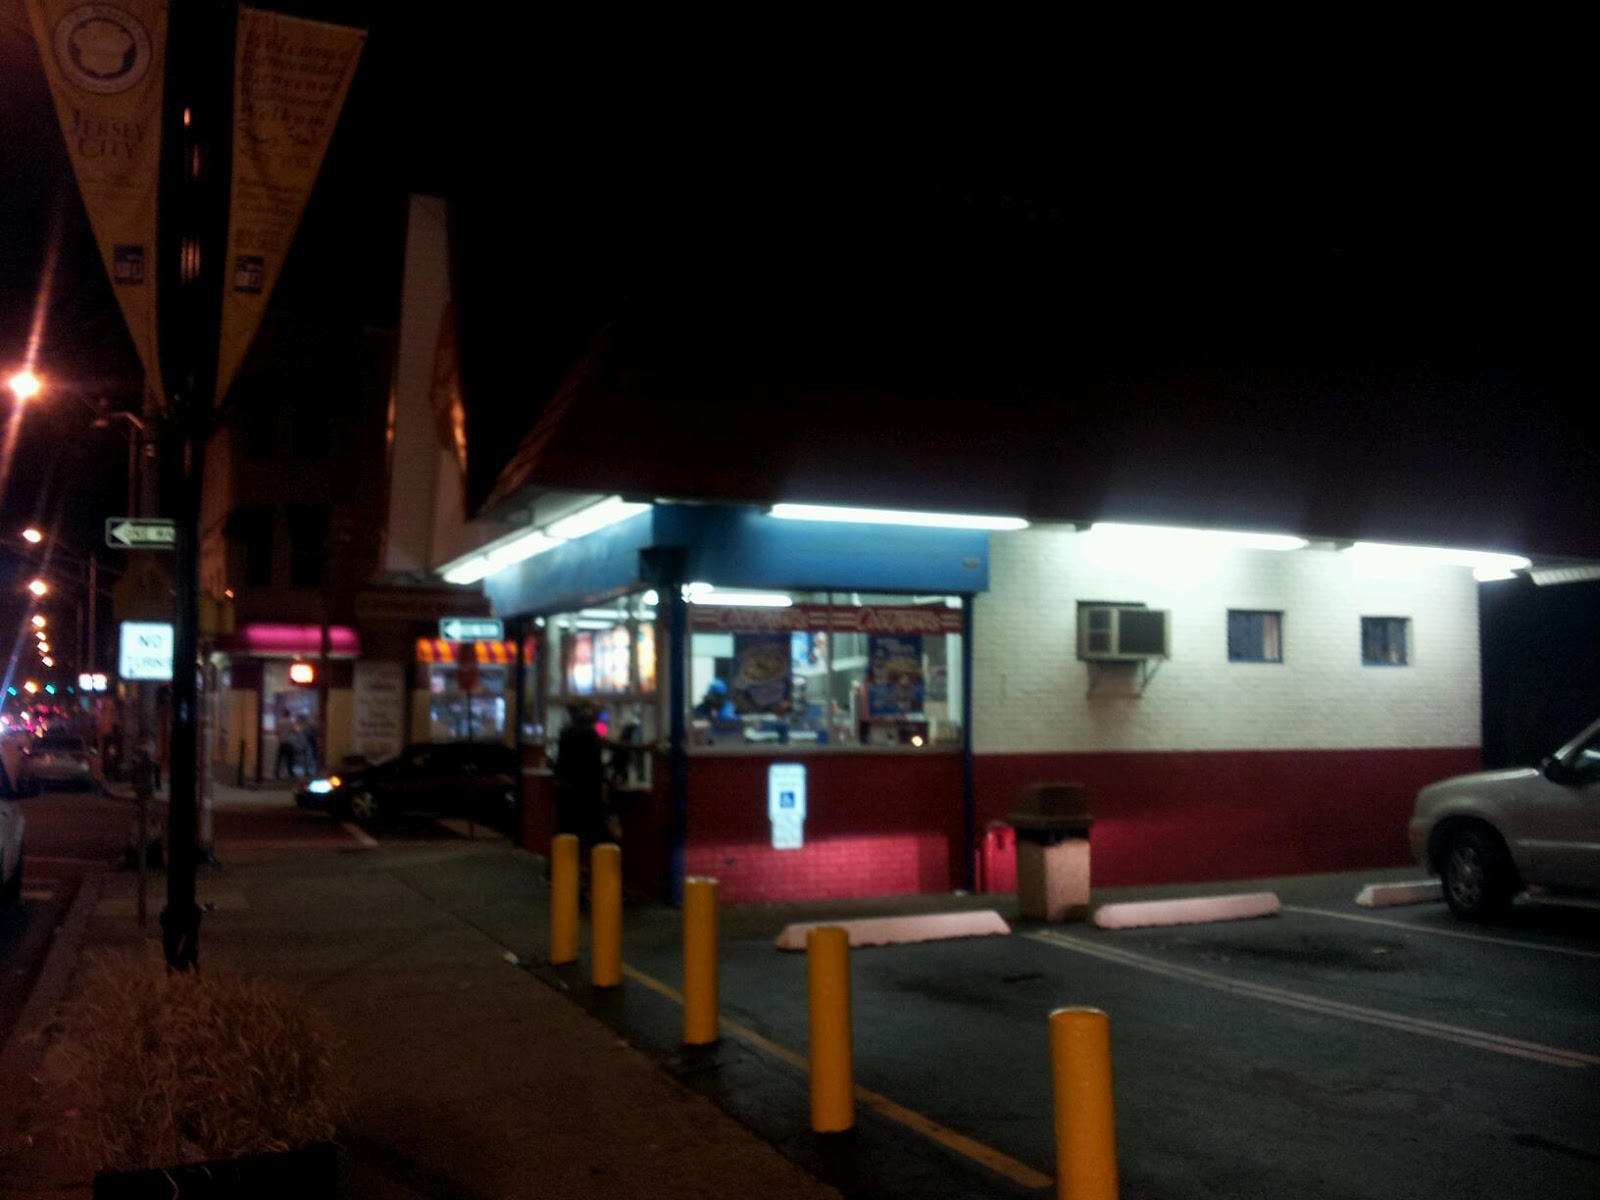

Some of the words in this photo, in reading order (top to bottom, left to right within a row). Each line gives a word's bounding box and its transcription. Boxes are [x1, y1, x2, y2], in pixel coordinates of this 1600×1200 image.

[69, 107, 146, 142] JERSEY
[78, 137, 137, 159] CITY
[138, 634, 163, 649] NO
